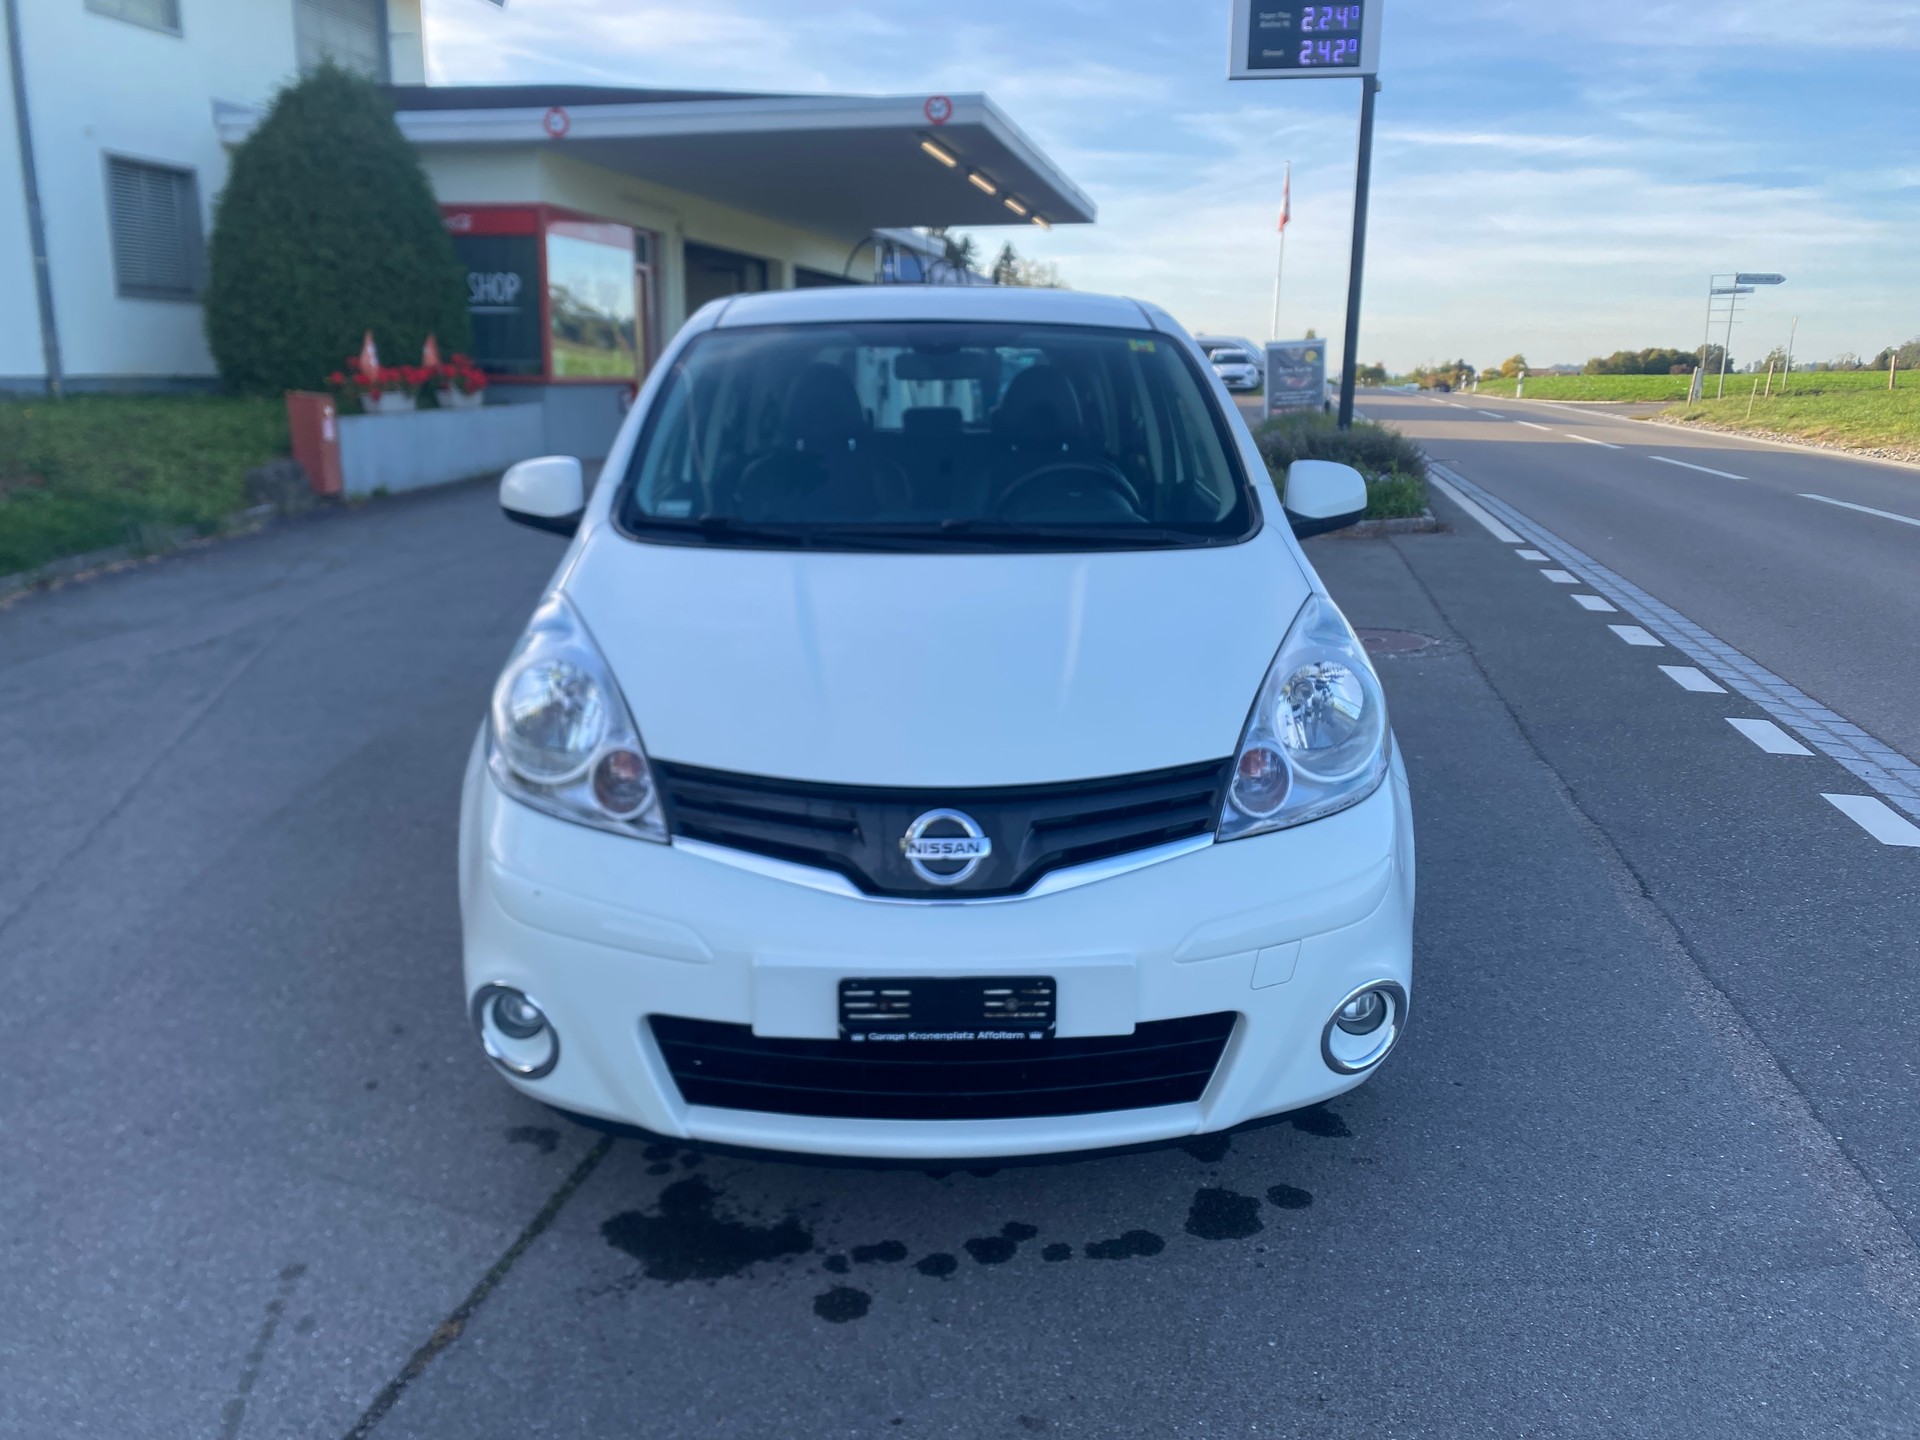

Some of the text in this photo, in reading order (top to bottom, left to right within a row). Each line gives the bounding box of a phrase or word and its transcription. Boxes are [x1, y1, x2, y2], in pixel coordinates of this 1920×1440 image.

[467, 271, 522, 304] SHOP
[908, 842, 981, 854] NISSAN
[868, 1030, 1025, 1042] Garage Kronenplatz Affoltern
